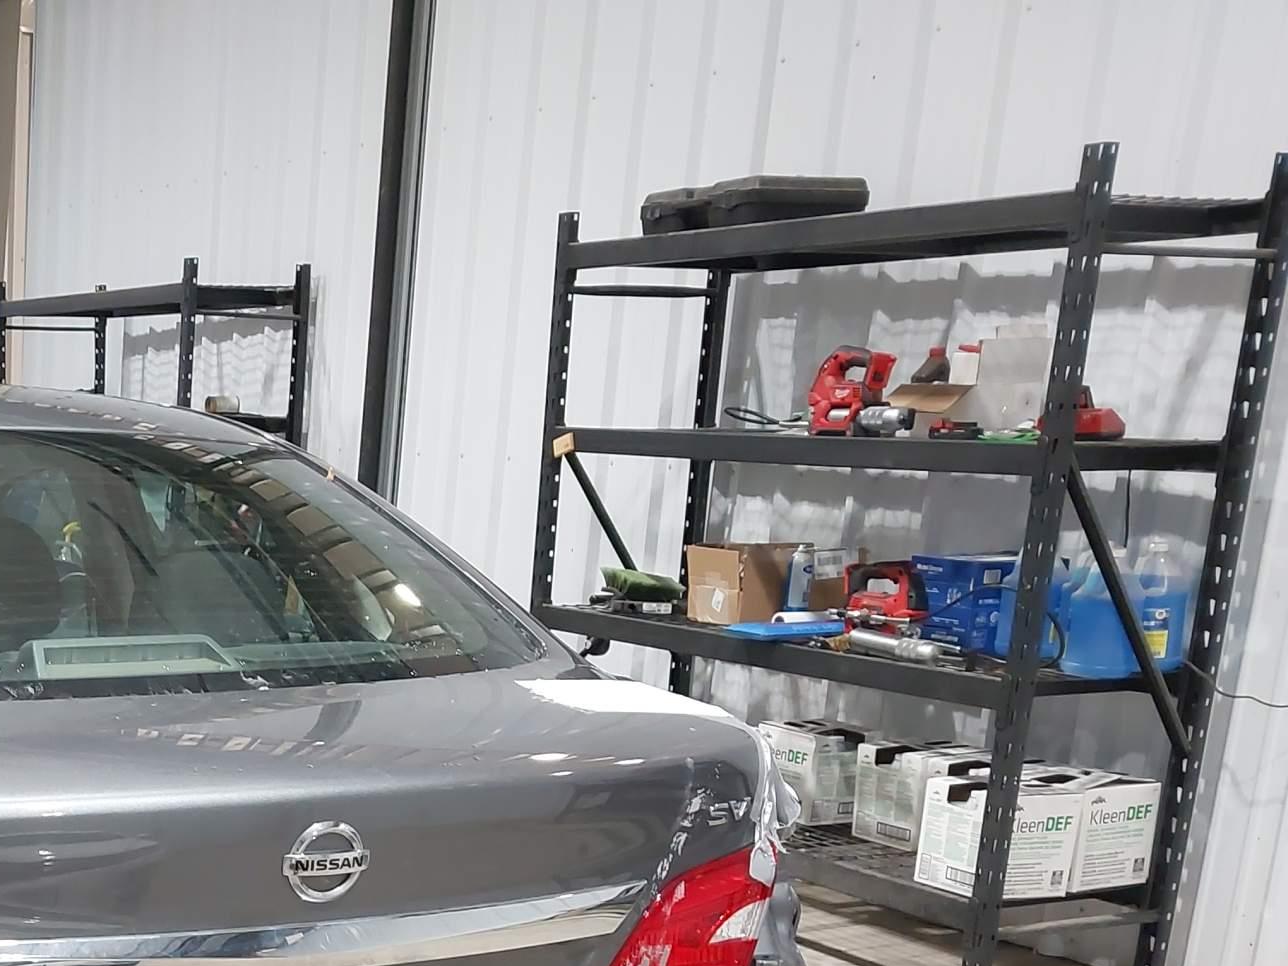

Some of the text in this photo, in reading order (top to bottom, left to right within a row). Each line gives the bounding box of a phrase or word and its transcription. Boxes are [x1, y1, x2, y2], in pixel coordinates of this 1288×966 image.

[707, 797, 752, 826] SV
[1089, 804, 1153, 826] KleenDEF
[294, 856, 363, 872] NISSAN
